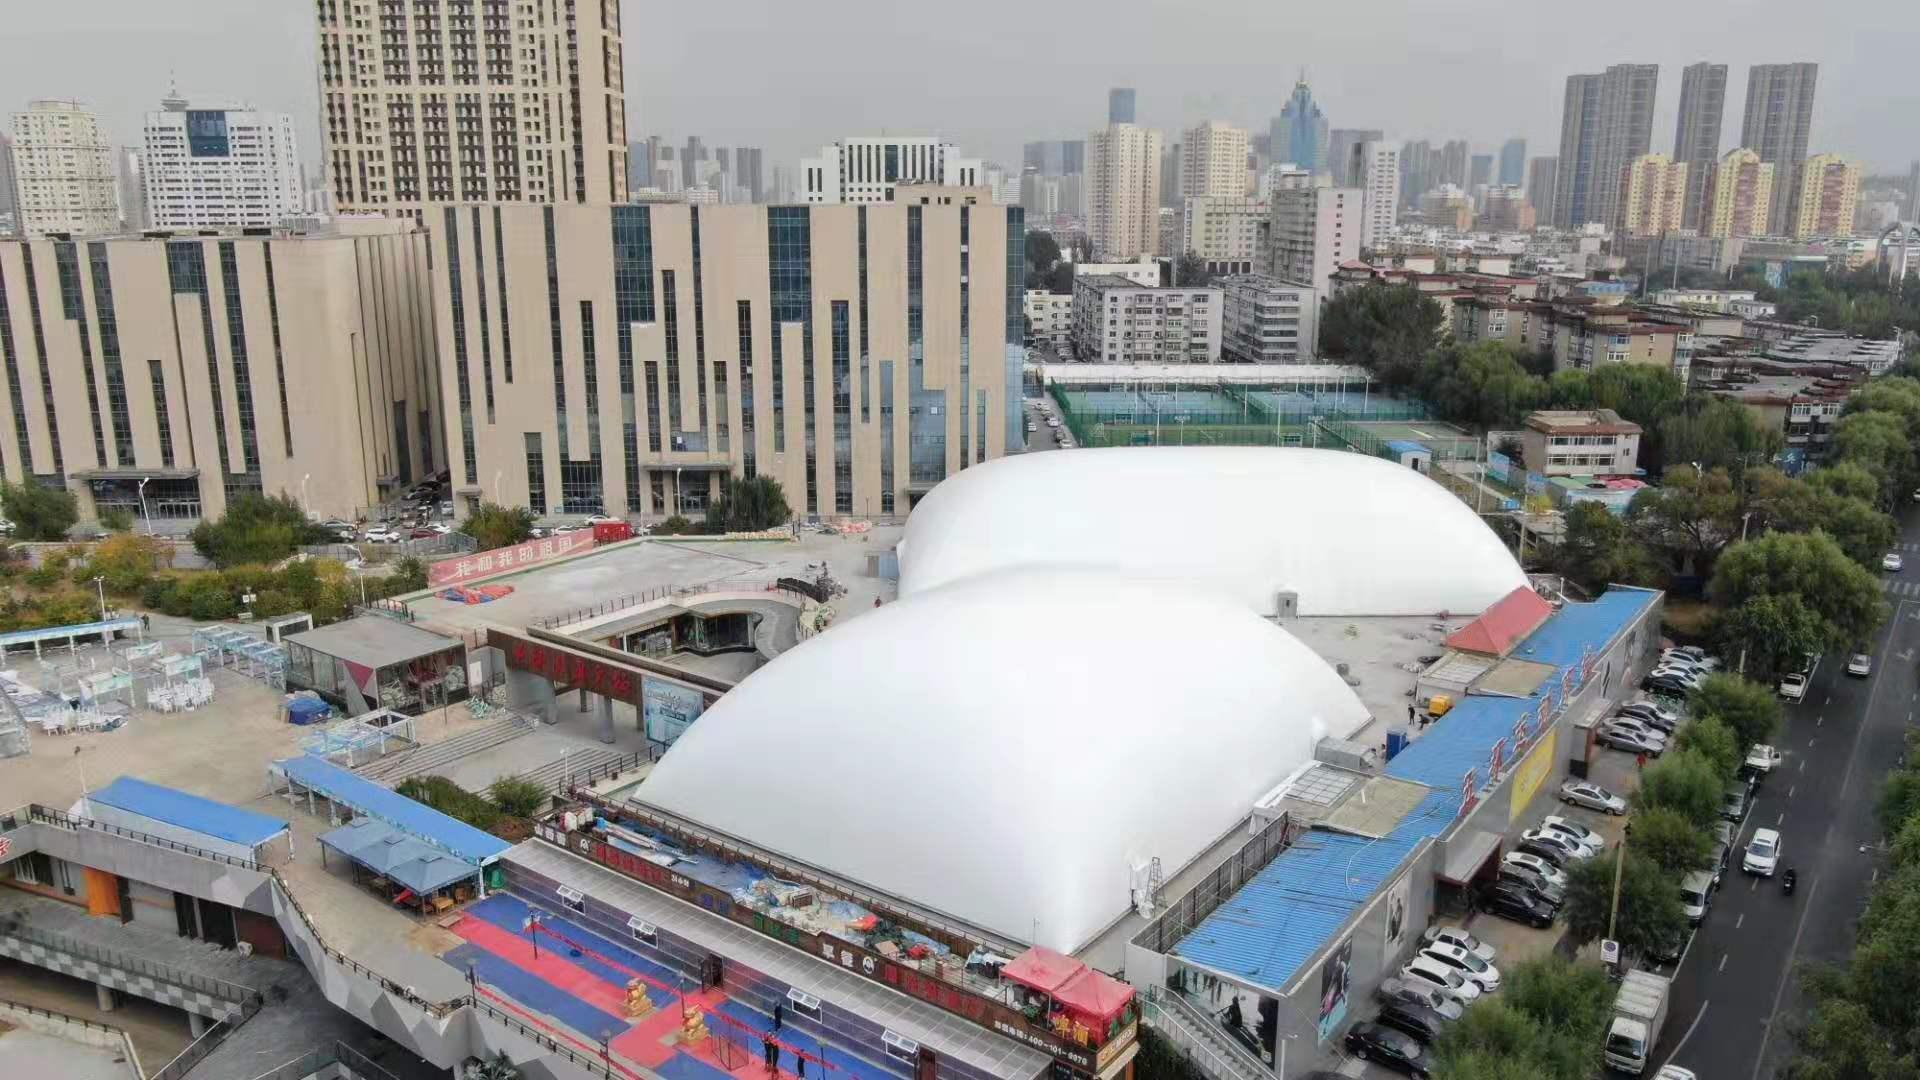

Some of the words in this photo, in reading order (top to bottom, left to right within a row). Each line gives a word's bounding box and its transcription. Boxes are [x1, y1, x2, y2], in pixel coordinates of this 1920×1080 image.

[456, 536, 572, 577] 我和我的祖国
[1055, 1014, 1090, 1047] 啤酒
